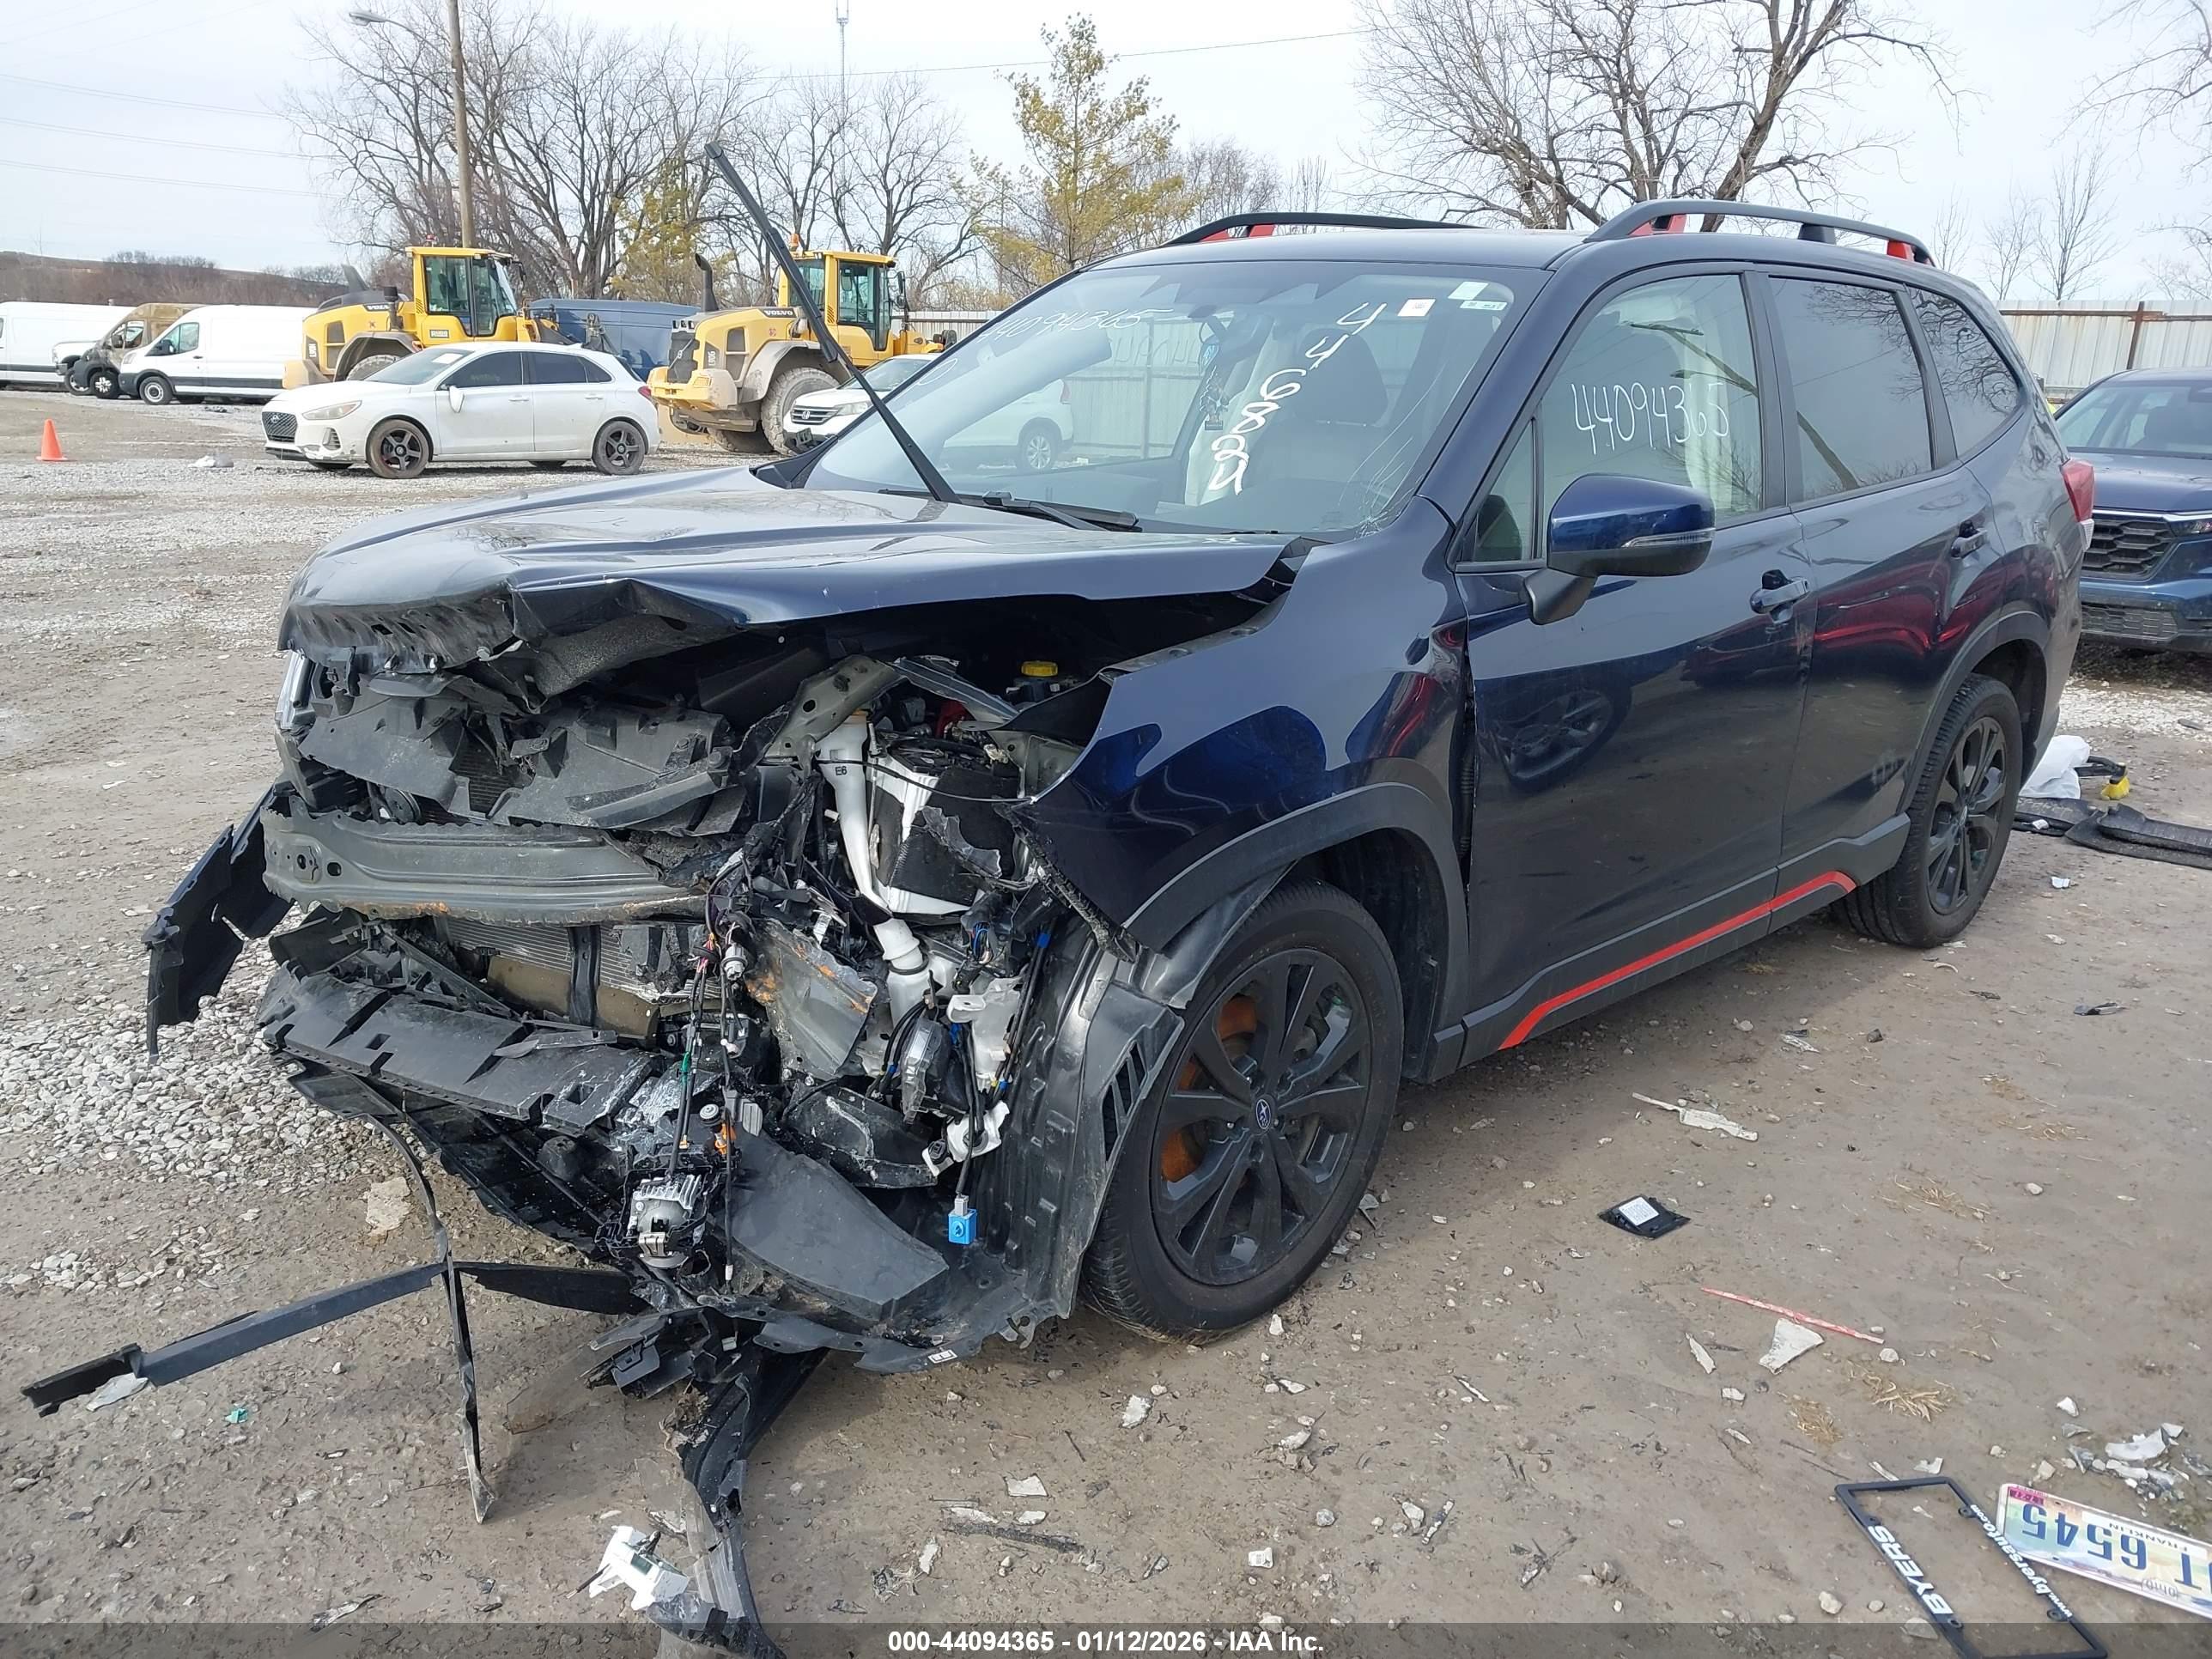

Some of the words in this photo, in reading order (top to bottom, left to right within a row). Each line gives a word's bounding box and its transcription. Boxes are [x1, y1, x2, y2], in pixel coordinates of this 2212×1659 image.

[1571, 382, 1729, 455] 44094365
[835, 765, 848, 776] E6
[1867, 1525, 1954, 1615] BYERS
[1970, 1504, 2073, 1618] www.byersauto.com
[2021, 1503, 2148, 1571] 6545
[2108, 1522, 2188, 1552] FRANKLIN
